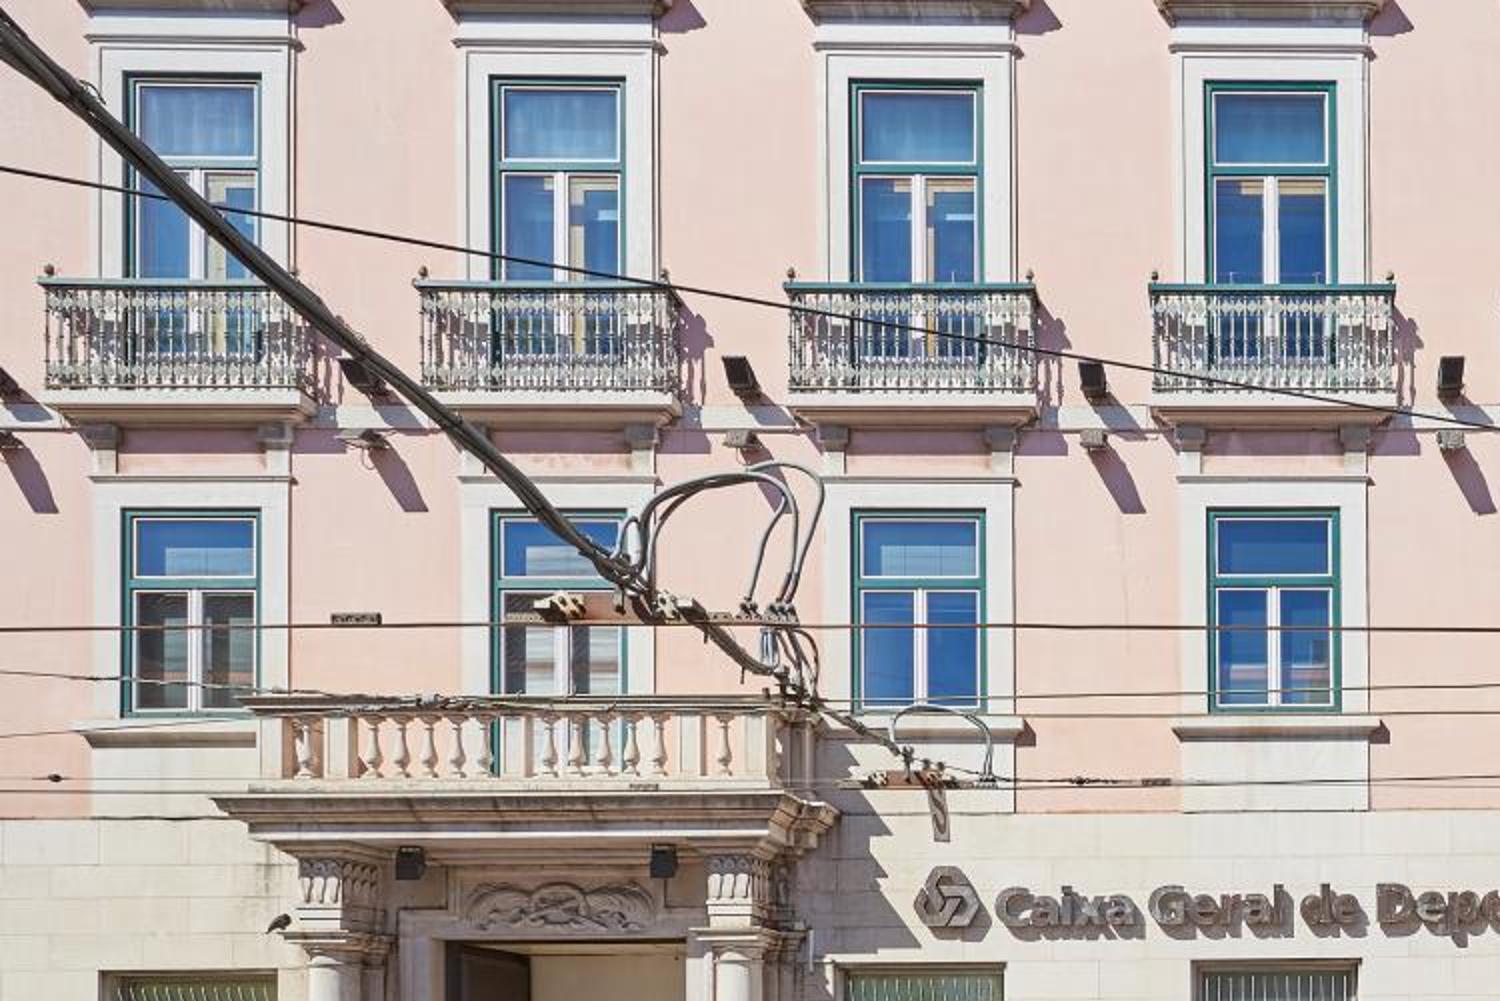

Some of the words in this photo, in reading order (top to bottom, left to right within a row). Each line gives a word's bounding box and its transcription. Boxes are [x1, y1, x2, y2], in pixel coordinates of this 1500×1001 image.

[996, 885, 1137, 930] Caixa
[1148, 884, 1288, 930] Geral
[1300, 883, 1363, 930] de
